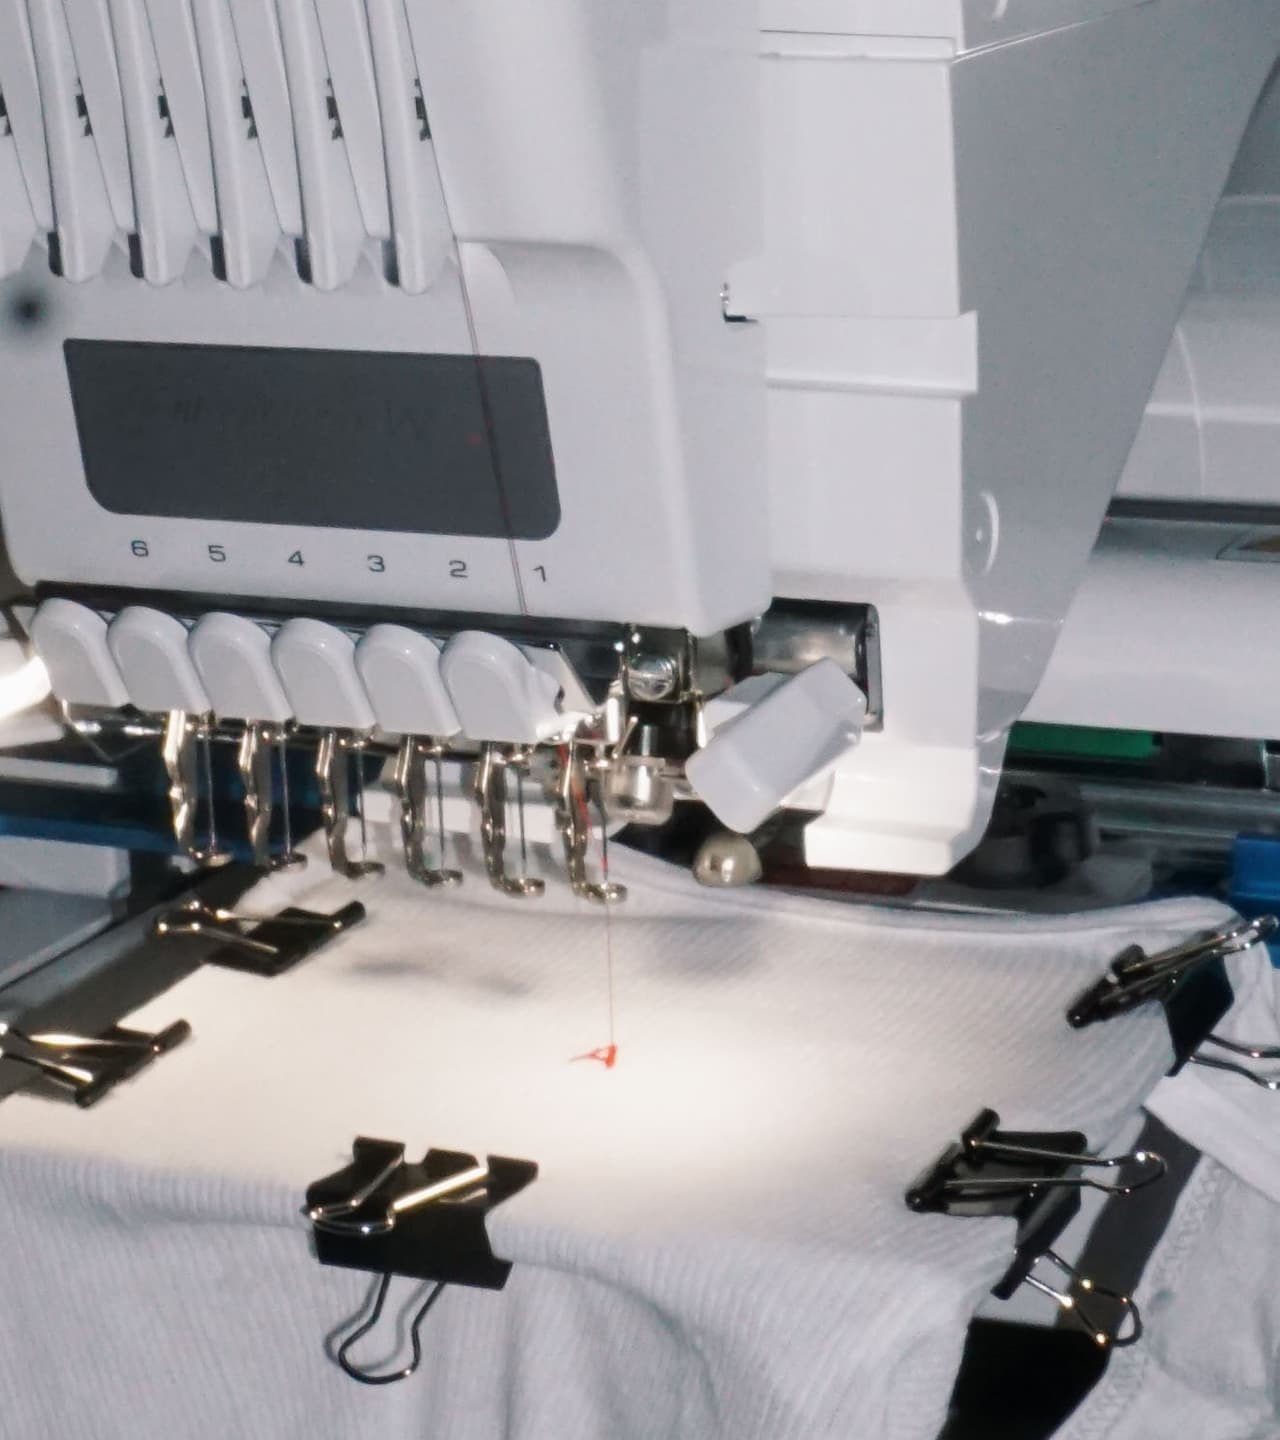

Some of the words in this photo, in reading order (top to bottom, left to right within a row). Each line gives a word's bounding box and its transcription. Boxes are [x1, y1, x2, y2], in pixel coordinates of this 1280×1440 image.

[130, 540, 149, 558] 6
[208, 544, 227, 563] 5
[287, 550, 305, 567] 4
[367, 554, 386, 573] 3
[448, 559, 468, 579] 2
[533, 564, 547, 583] 1
